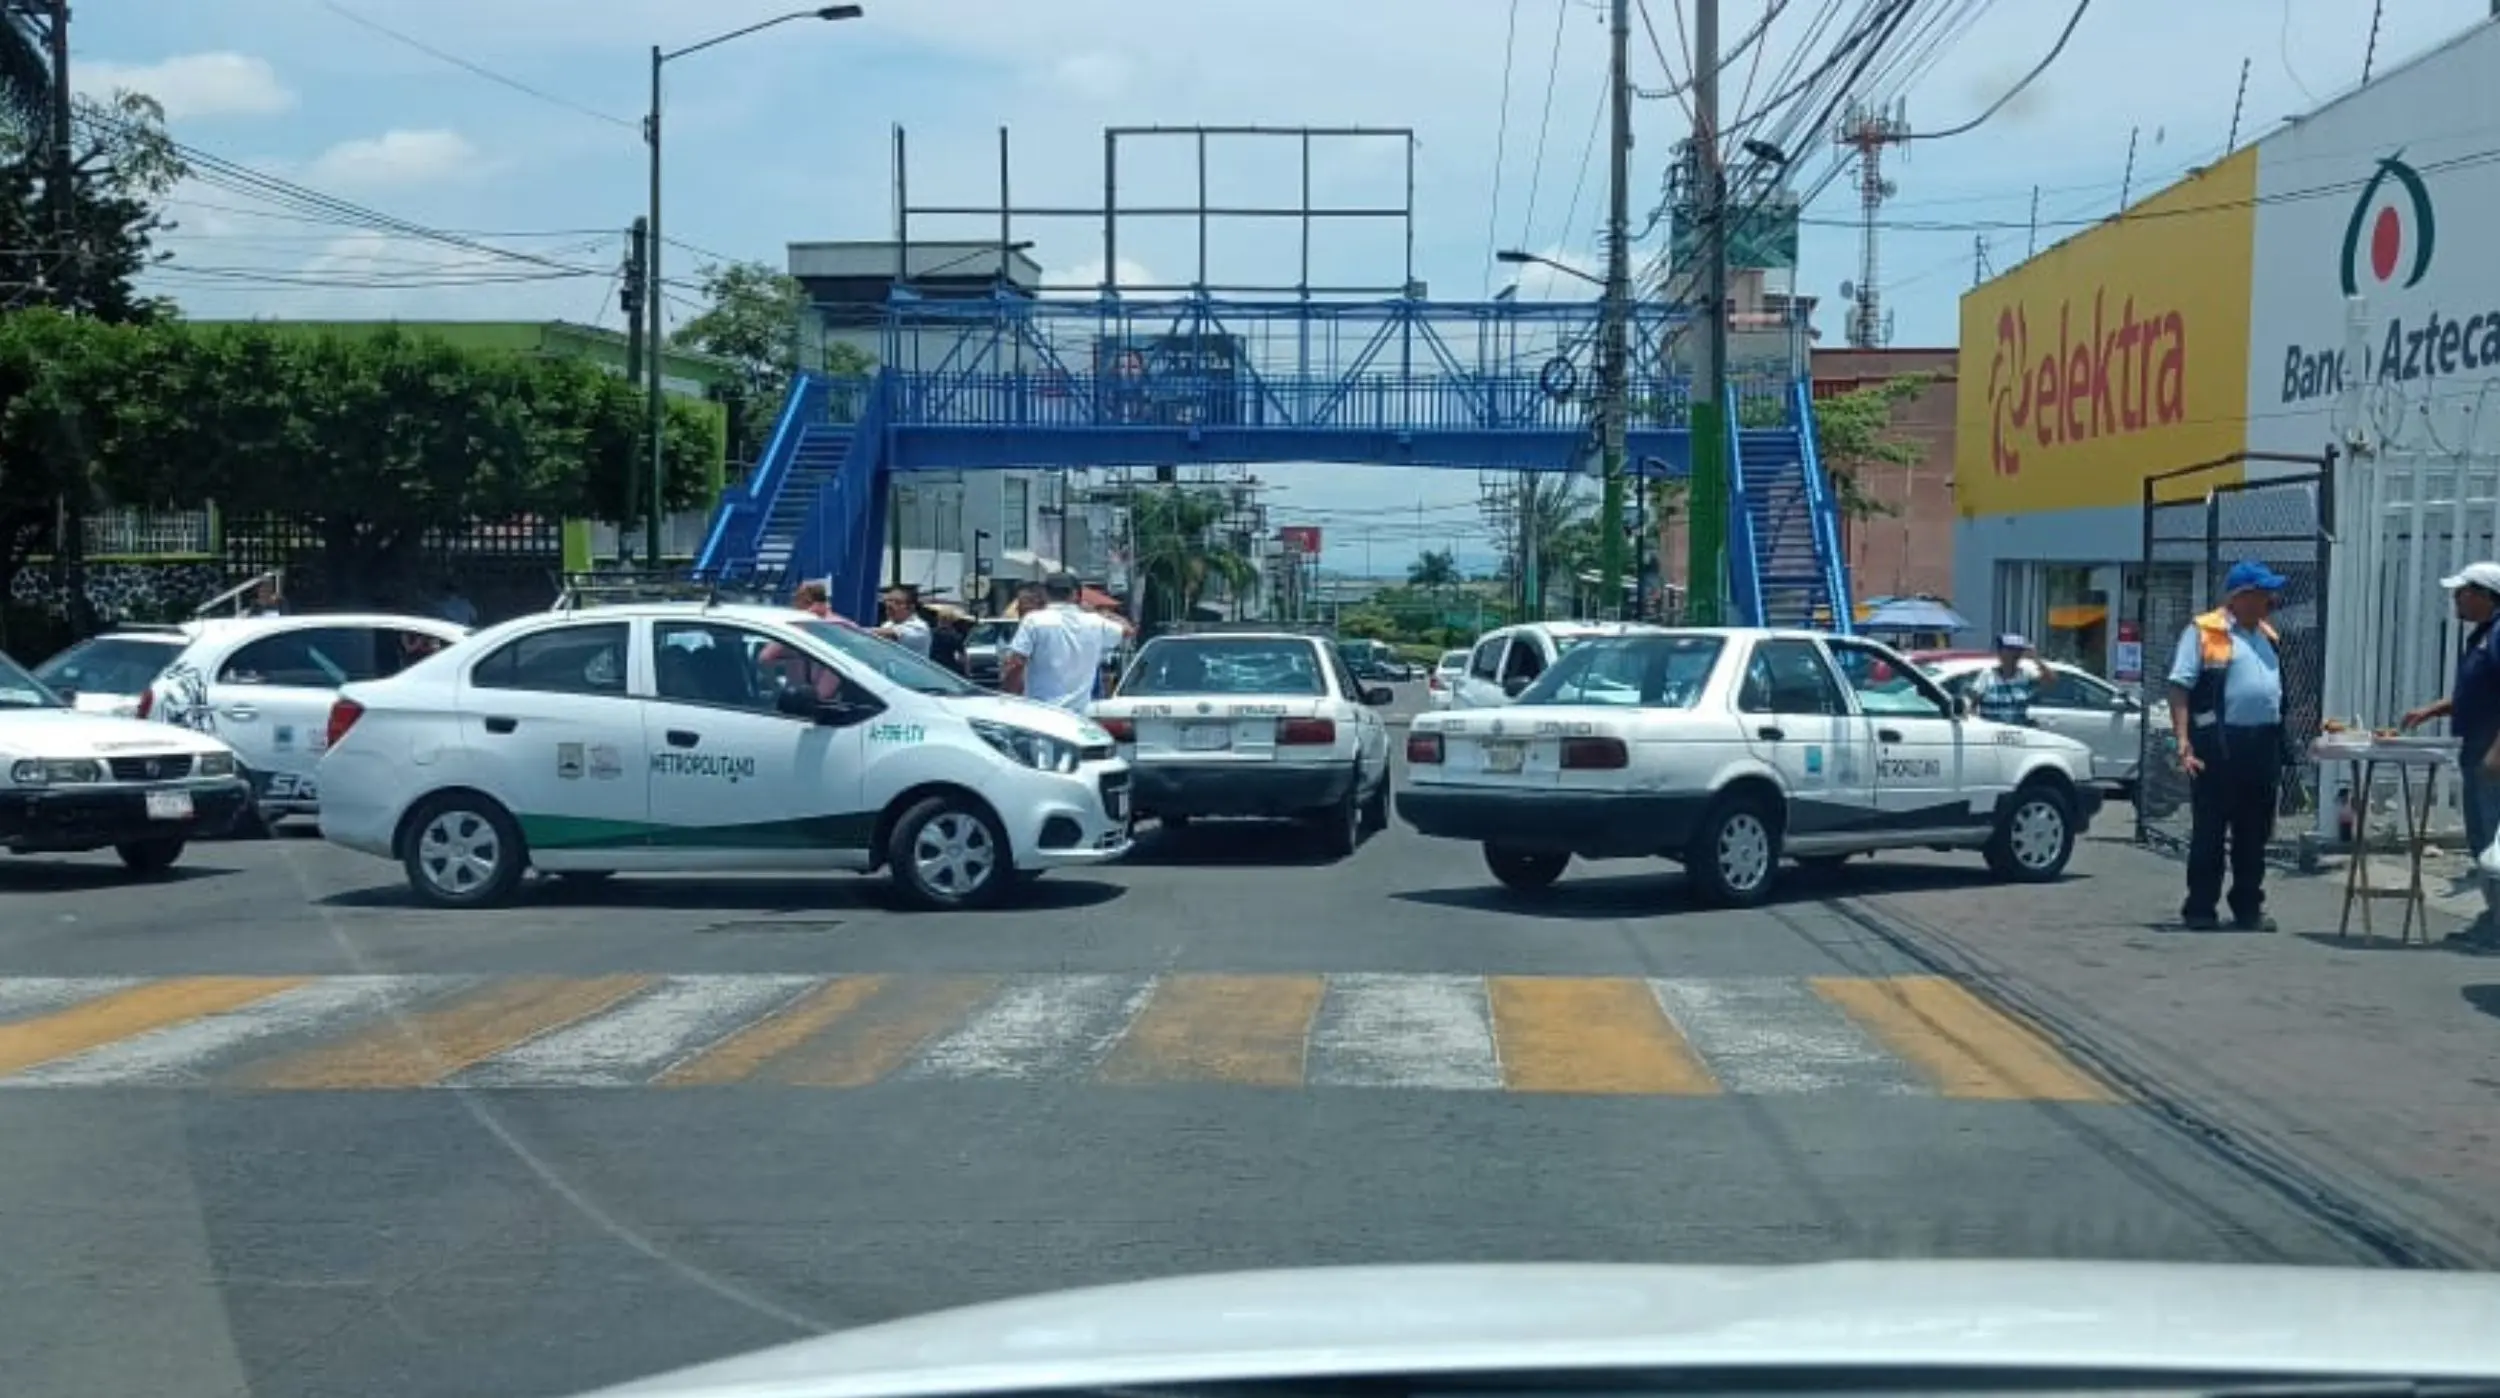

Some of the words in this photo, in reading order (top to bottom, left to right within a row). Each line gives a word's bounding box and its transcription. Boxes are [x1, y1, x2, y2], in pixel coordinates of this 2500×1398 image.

[2035, 285, 2184, 446] elektra
[2377, 311, 2500, 385] Azteca
[650, 752, 755, 777] METROPOLITANO
